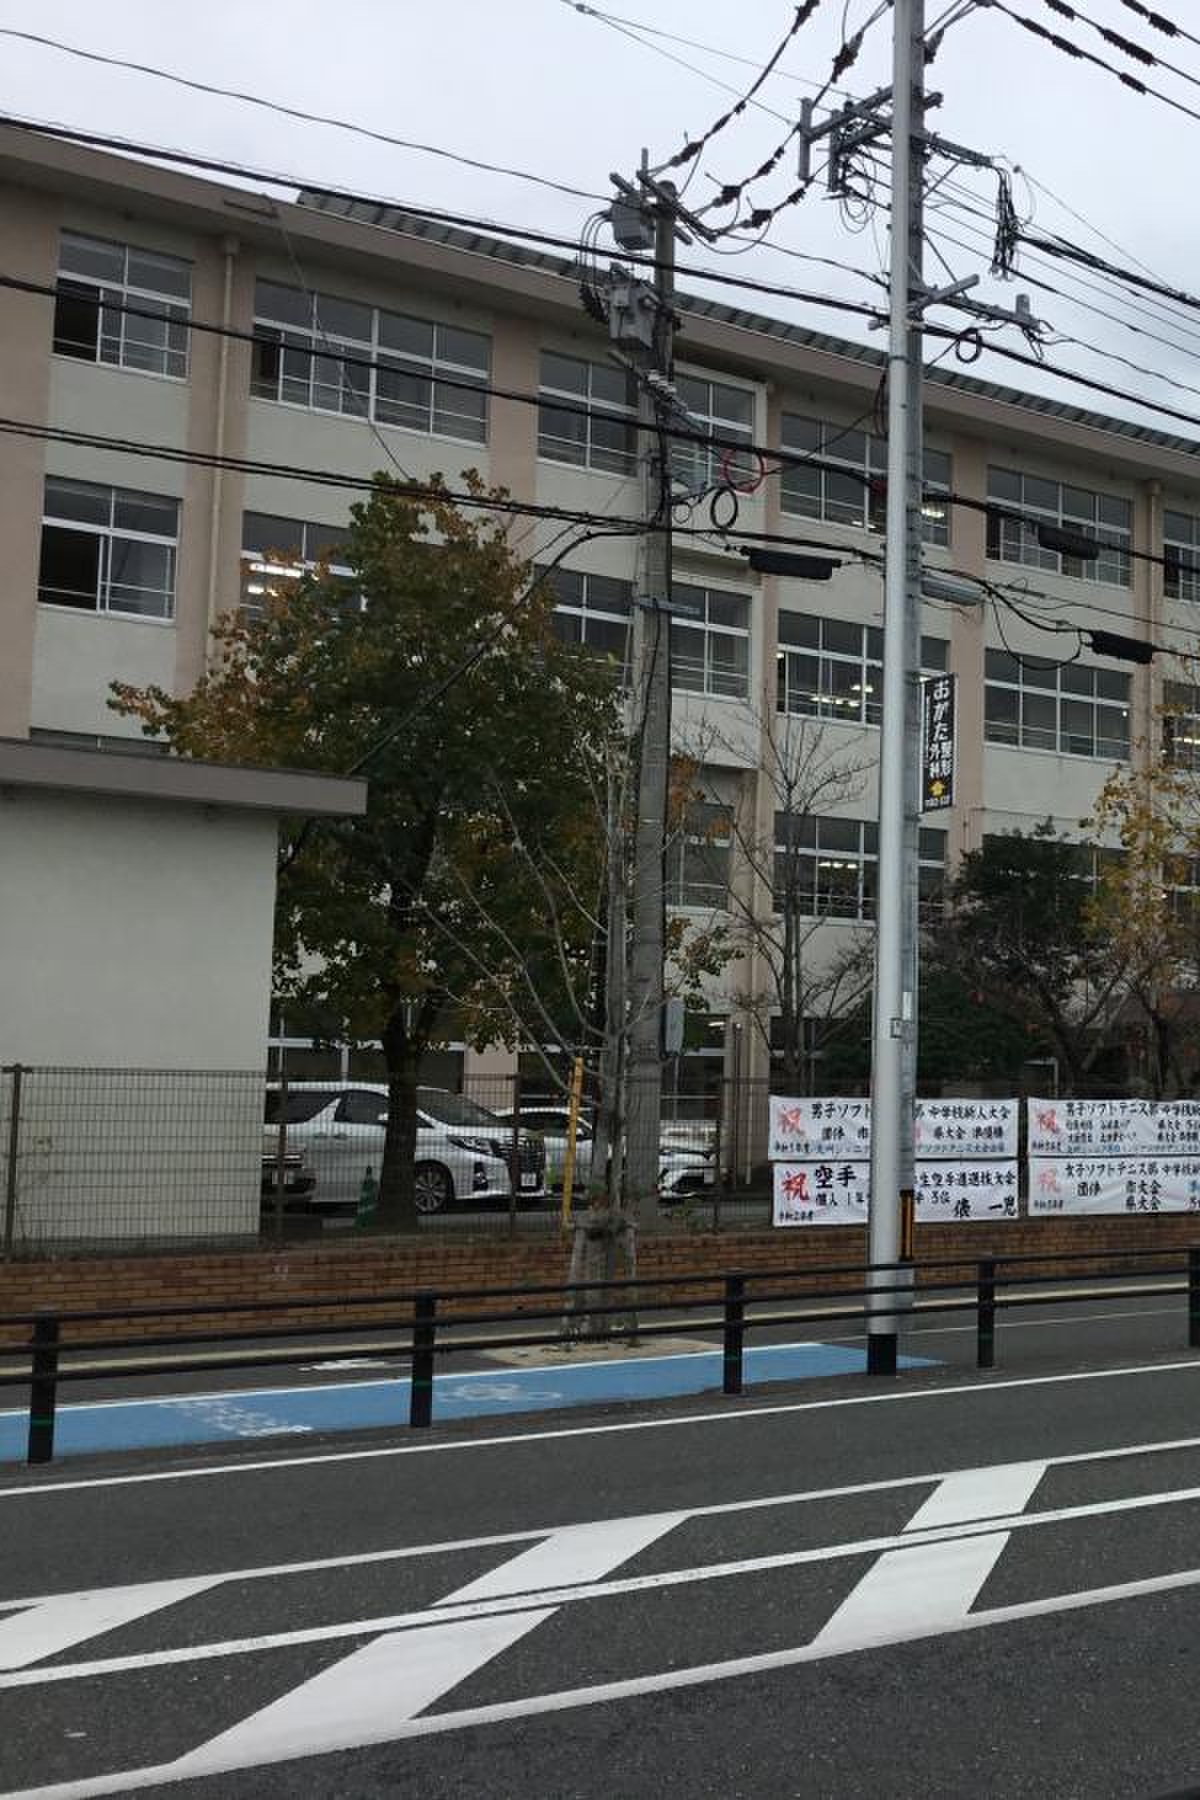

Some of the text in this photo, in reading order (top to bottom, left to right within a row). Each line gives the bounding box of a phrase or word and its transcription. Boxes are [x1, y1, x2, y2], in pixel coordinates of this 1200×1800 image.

[933, 679, 950, 741] おがた
[778, 1103, 805, 1136] 祝
[782, 1170, 810, 1201] 祝
[815, 1164, 857, 1188] 空手
